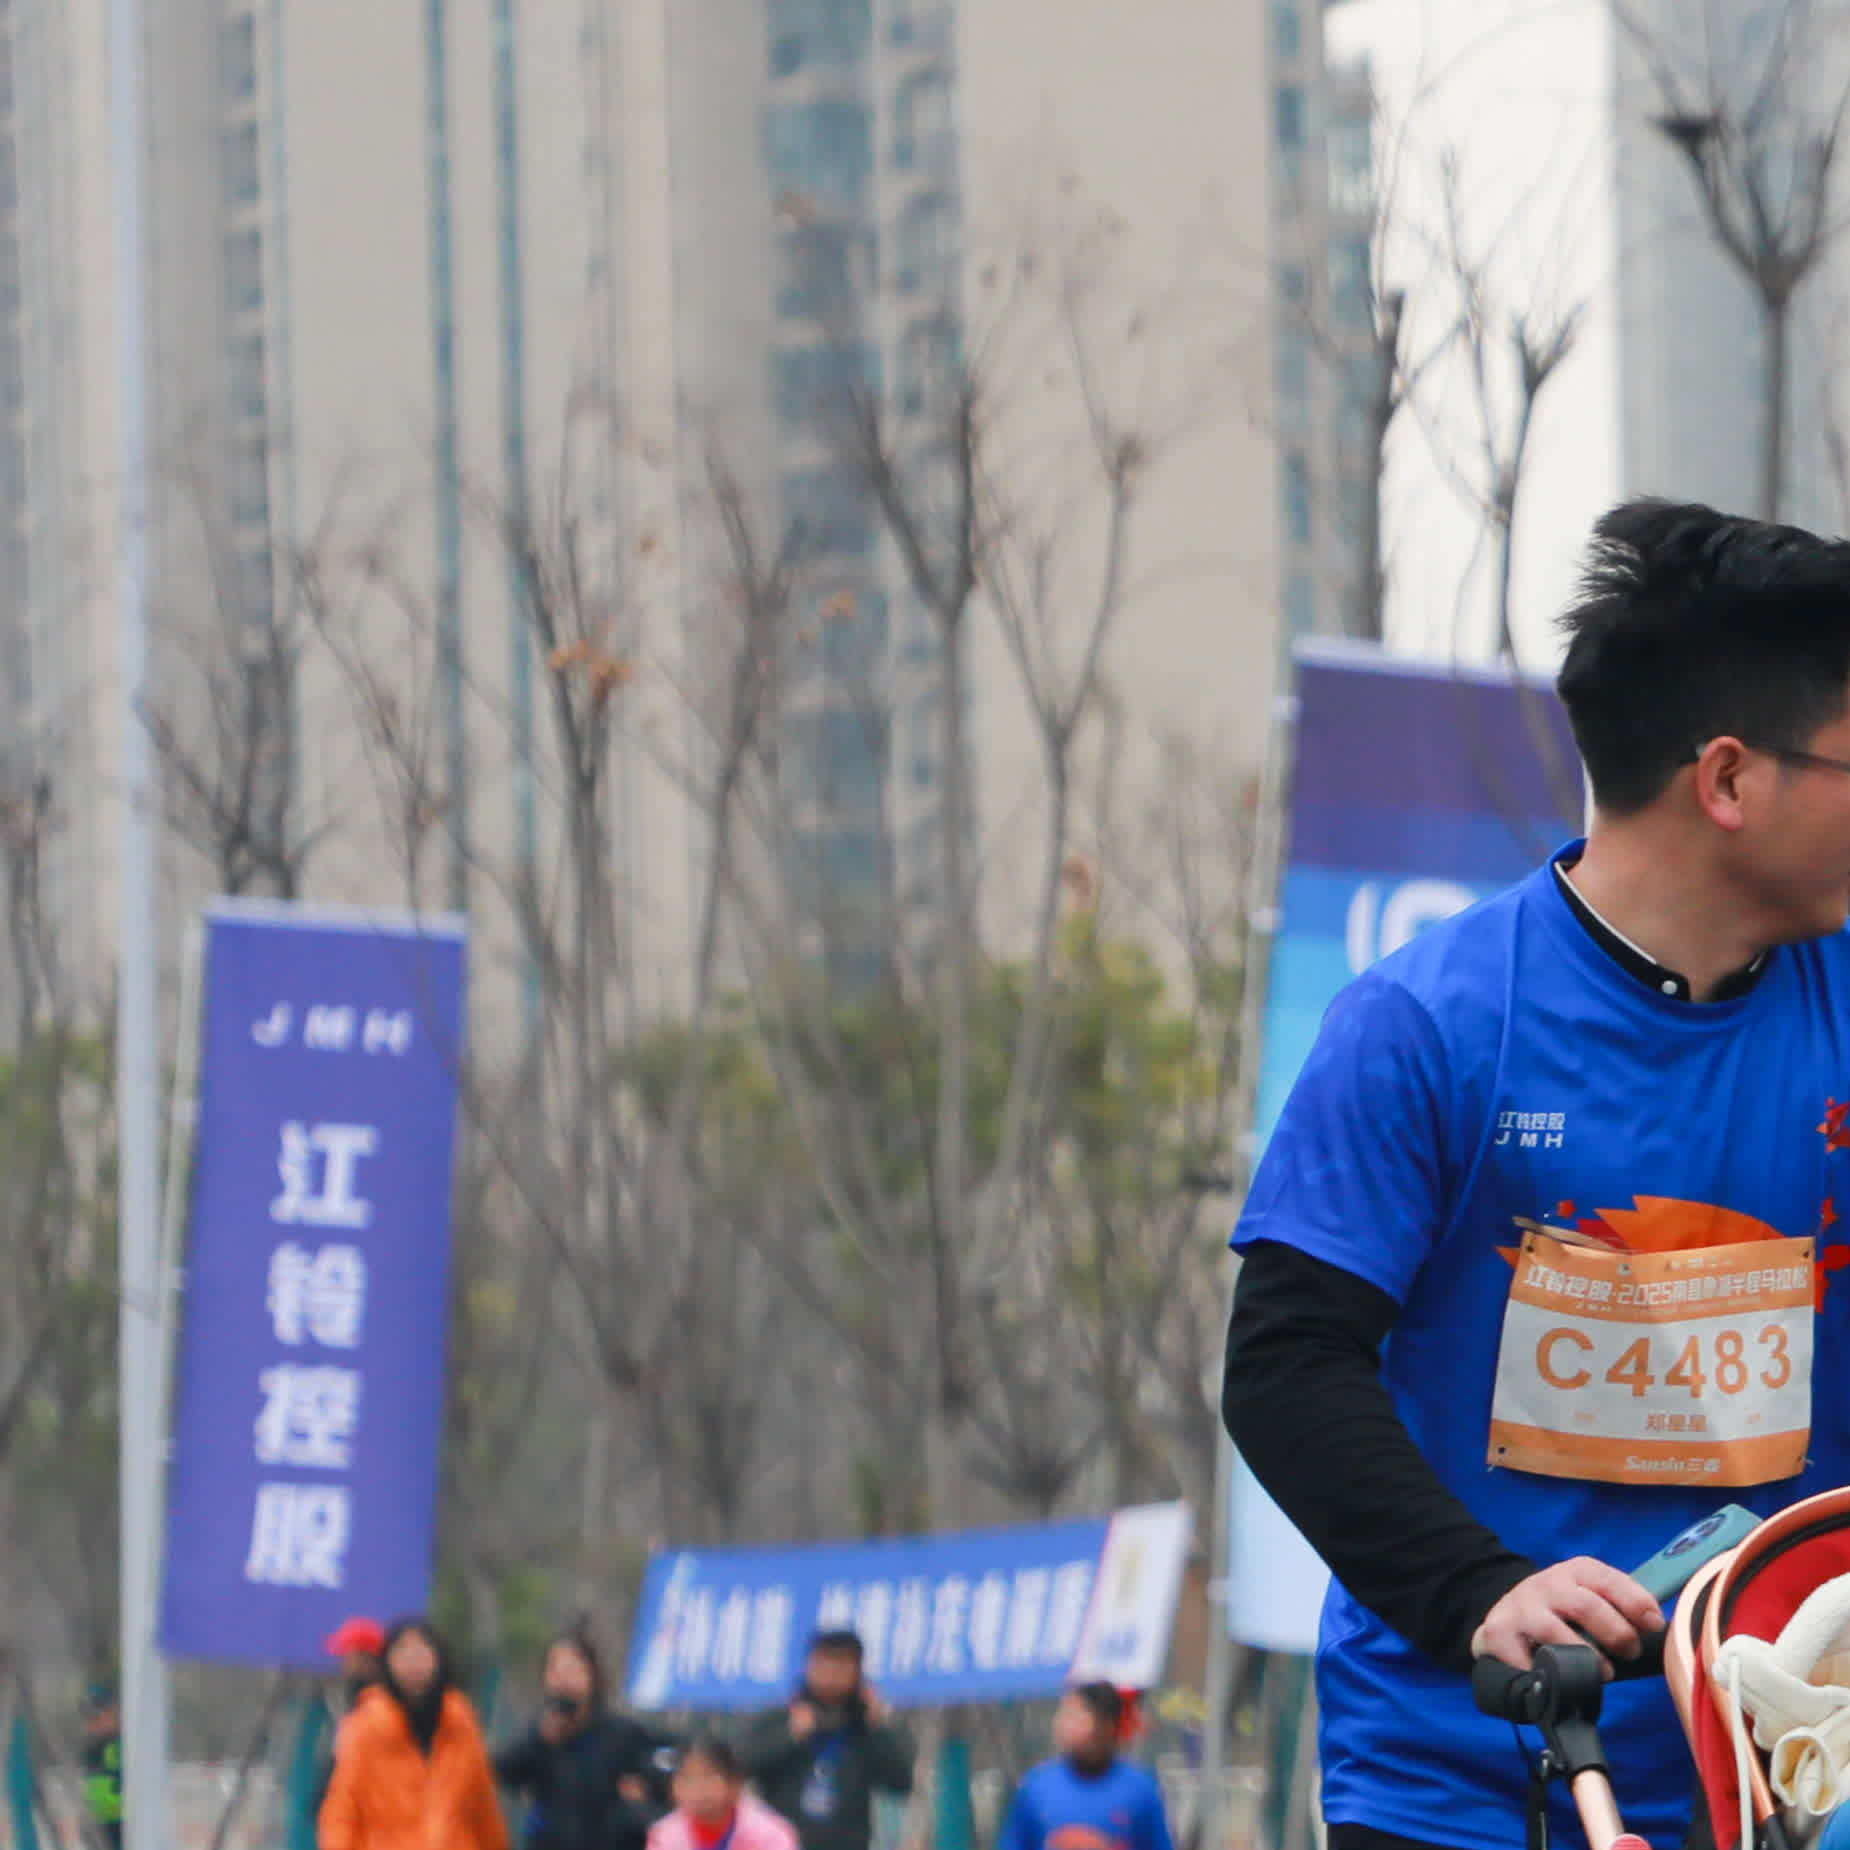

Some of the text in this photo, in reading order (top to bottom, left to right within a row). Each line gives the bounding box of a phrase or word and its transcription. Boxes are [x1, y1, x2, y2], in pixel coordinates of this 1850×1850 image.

[251, 1001, 413, 1055] JMH
[1494, 1130, 1564, 1149] JMH
[1497, 1111, 1566, 1131] 江铃控股
[244, 1119, 381, 1589] 江铃控股
[1535, 1325, 1792, 1399] C4483
